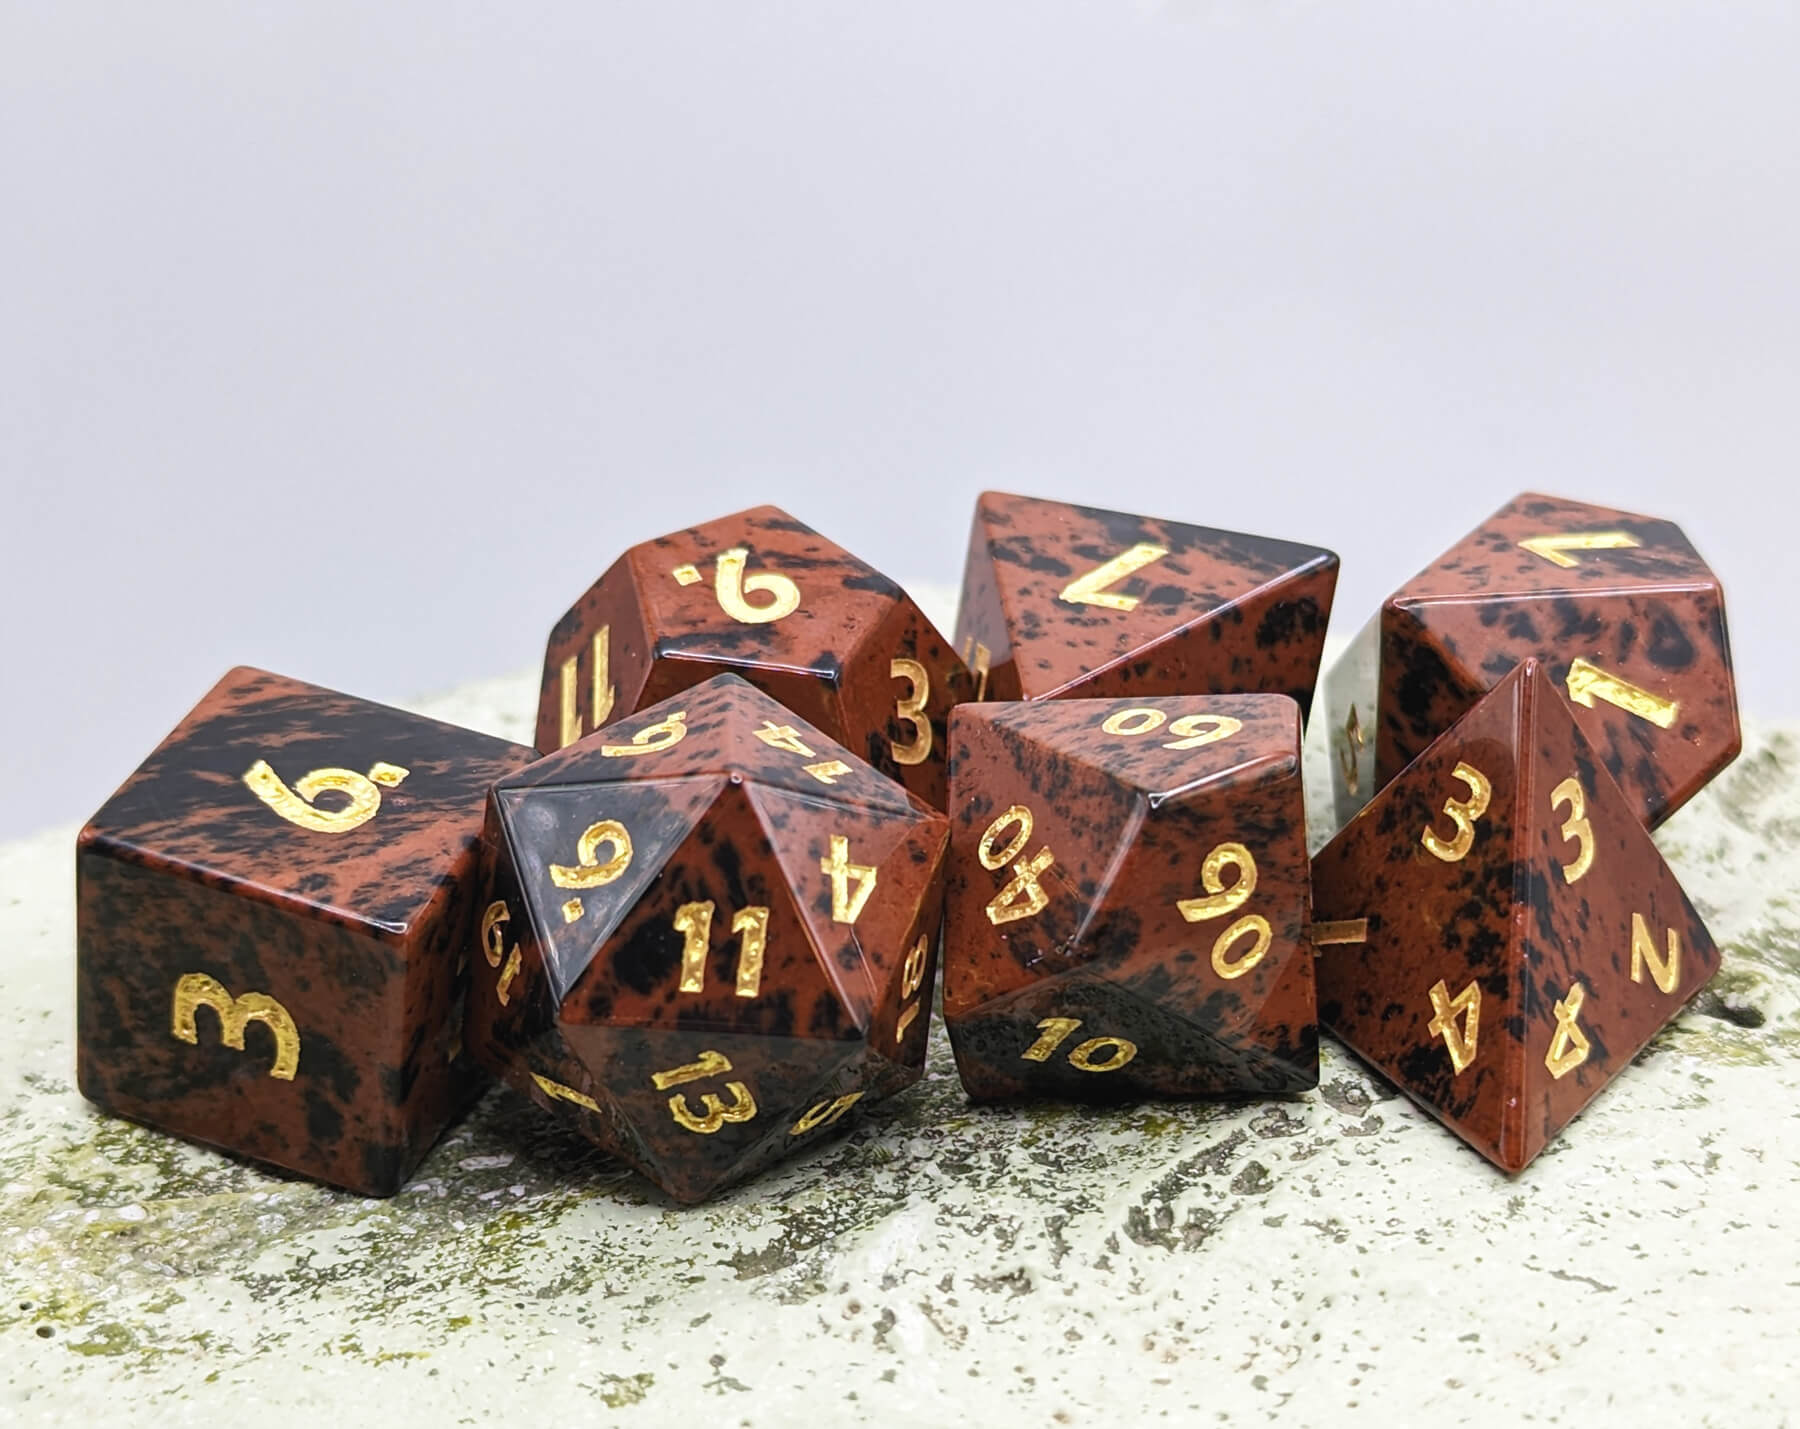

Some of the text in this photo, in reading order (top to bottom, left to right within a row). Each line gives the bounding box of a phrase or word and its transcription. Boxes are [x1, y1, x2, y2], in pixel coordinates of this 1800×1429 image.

[1059, 541, 1169, 612] 7
[890, 658, 933, 765] 3
[1565, 657, 1679, 729] 1
[1421, 761, 1492, 862] 3
[1551, 776, 1596, 885] 3
[820, 834, 878, 925] 4
[1176, 841, 1272, 980] 90
[673, 900, 770, 998] 11
[1630, 912, 1680, 995] 2
[171, 972, 300, 1082] 3
[1020, 1017, 1138, 1072] 10
[1427, 979, 1482, 1077] 4
[1544, 982, 1591, 1080] 4
[651, 1050, 758, 1134] 13
